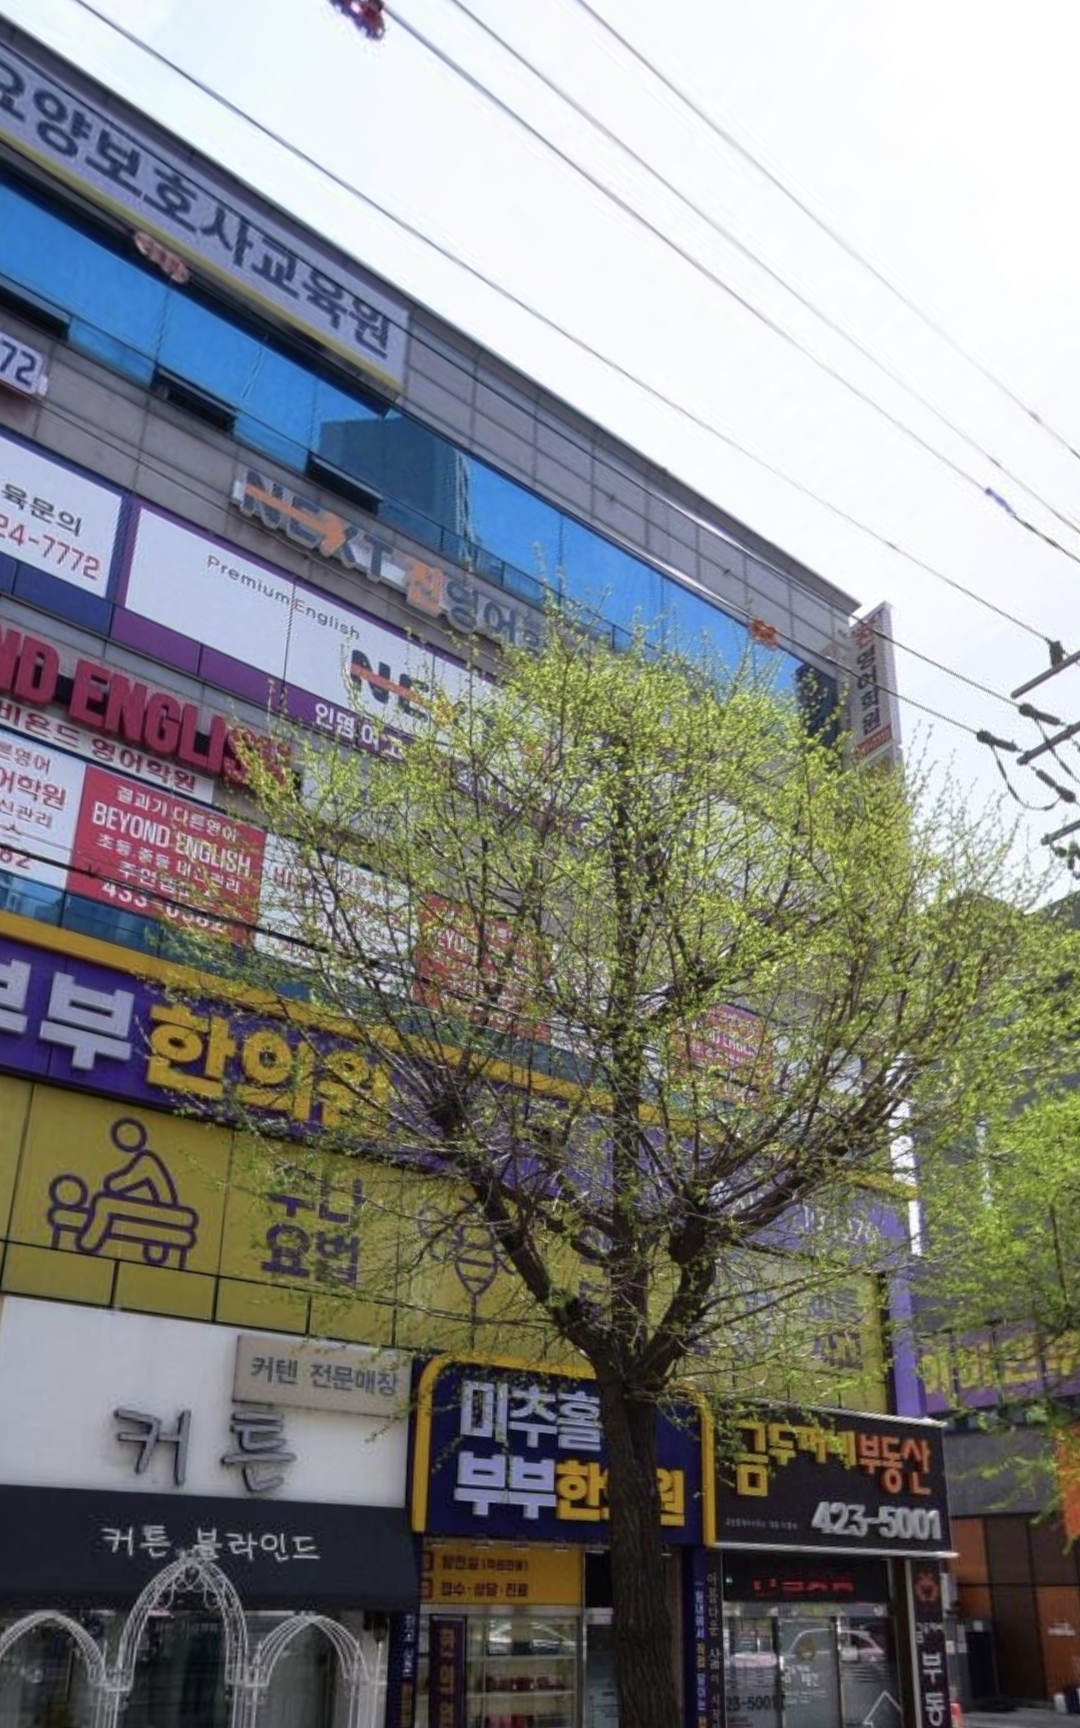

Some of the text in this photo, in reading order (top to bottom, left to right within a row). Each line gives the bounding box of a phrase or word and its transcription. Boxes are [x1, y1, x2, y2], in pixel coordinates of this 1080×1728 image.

[206, 555, 361, 640] Premium English
[92, 738, 196, 793] 영어학원
[92, 801, 251, 878] BEYOND ENGLISH
[251, 1356, 399, 1395] 커텐 전문매장
[113, 1408, 296, 1492] 커튼
[460, 1380, 602, 1451] 미추홀
[453, 1451, 686, 1527] 부부한원
[811, 1501, 942, 1541] 423-5001
[101, 1524, 320, 1562] 커튼 블라인드
